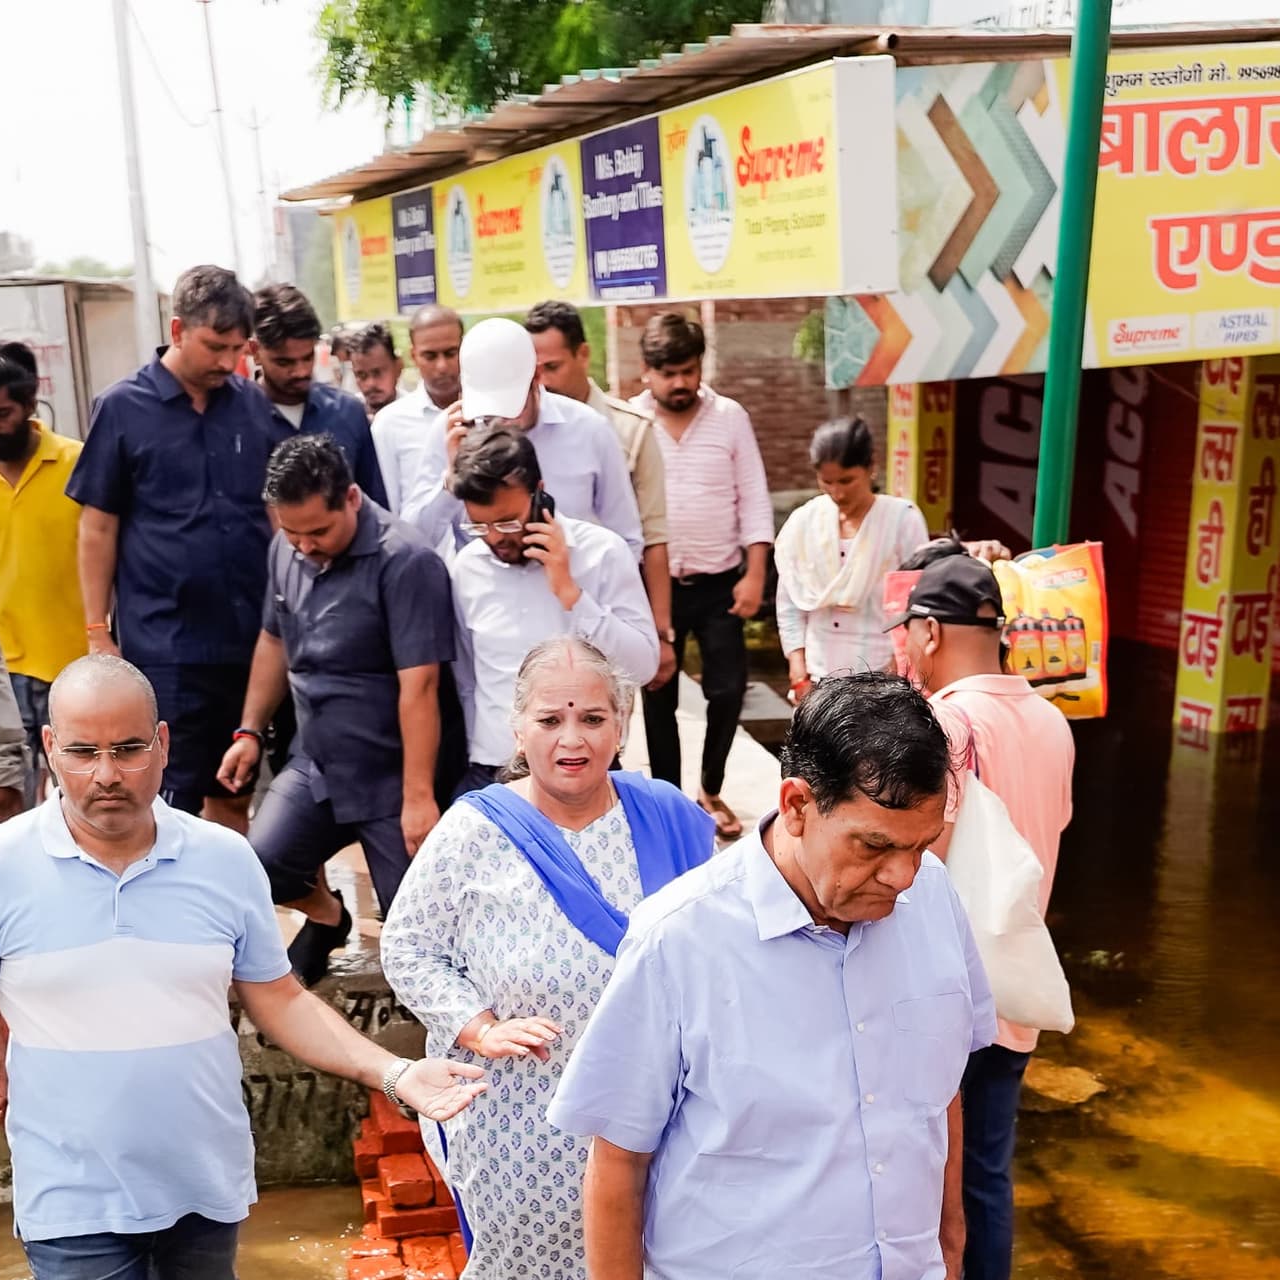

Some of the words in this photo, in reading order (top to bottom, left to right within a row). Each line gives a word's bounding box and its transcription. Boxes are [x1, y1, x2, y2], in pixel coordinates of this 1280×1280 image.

[736, 125, 825, 200] Supreme
[1113, 320, 1183, 345] Supreme
[1219, 311, 1269, 330] ASTRAL
[1223, 329, 1260, 344] PIPES
[1195, 500, 1226, 584] ही
